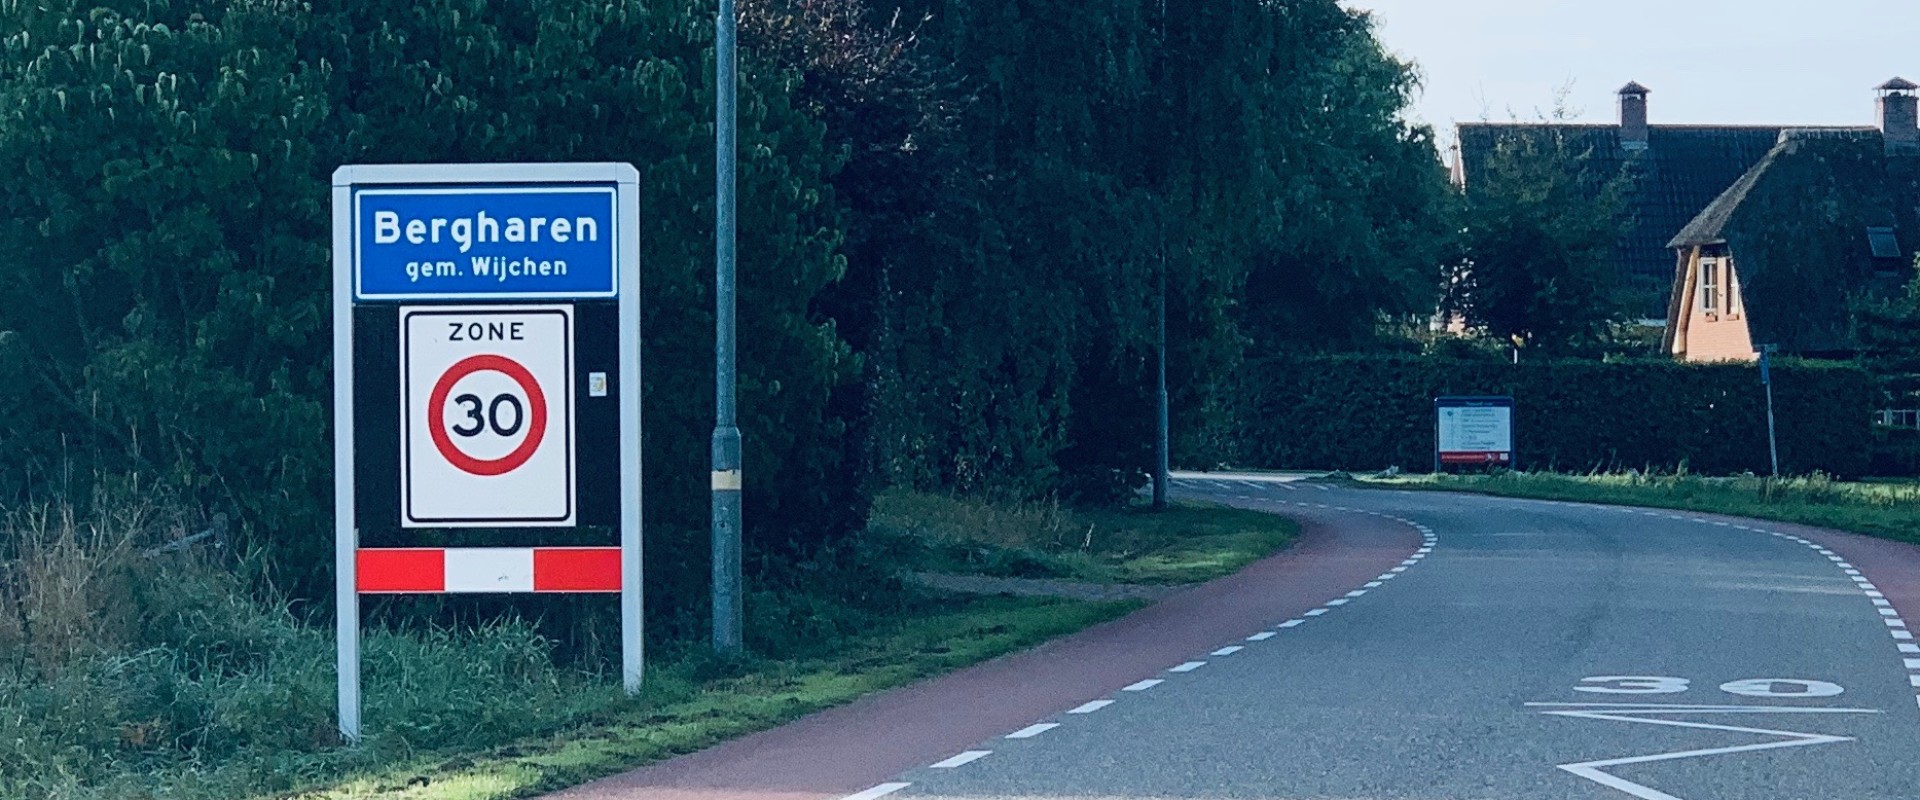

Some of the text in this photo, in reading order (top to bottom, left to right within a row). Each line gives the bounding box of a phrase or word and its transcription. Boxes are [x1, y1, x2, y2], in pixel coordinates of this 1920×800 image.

[374, 210, 598, 254] Bergharen
[405, 256, 568, 282] gem. Wijchen
[449, 322, 524, 341] ZONE
[452, 393, 524, 437] 30
[1572, 675, 1845, 697] 30
